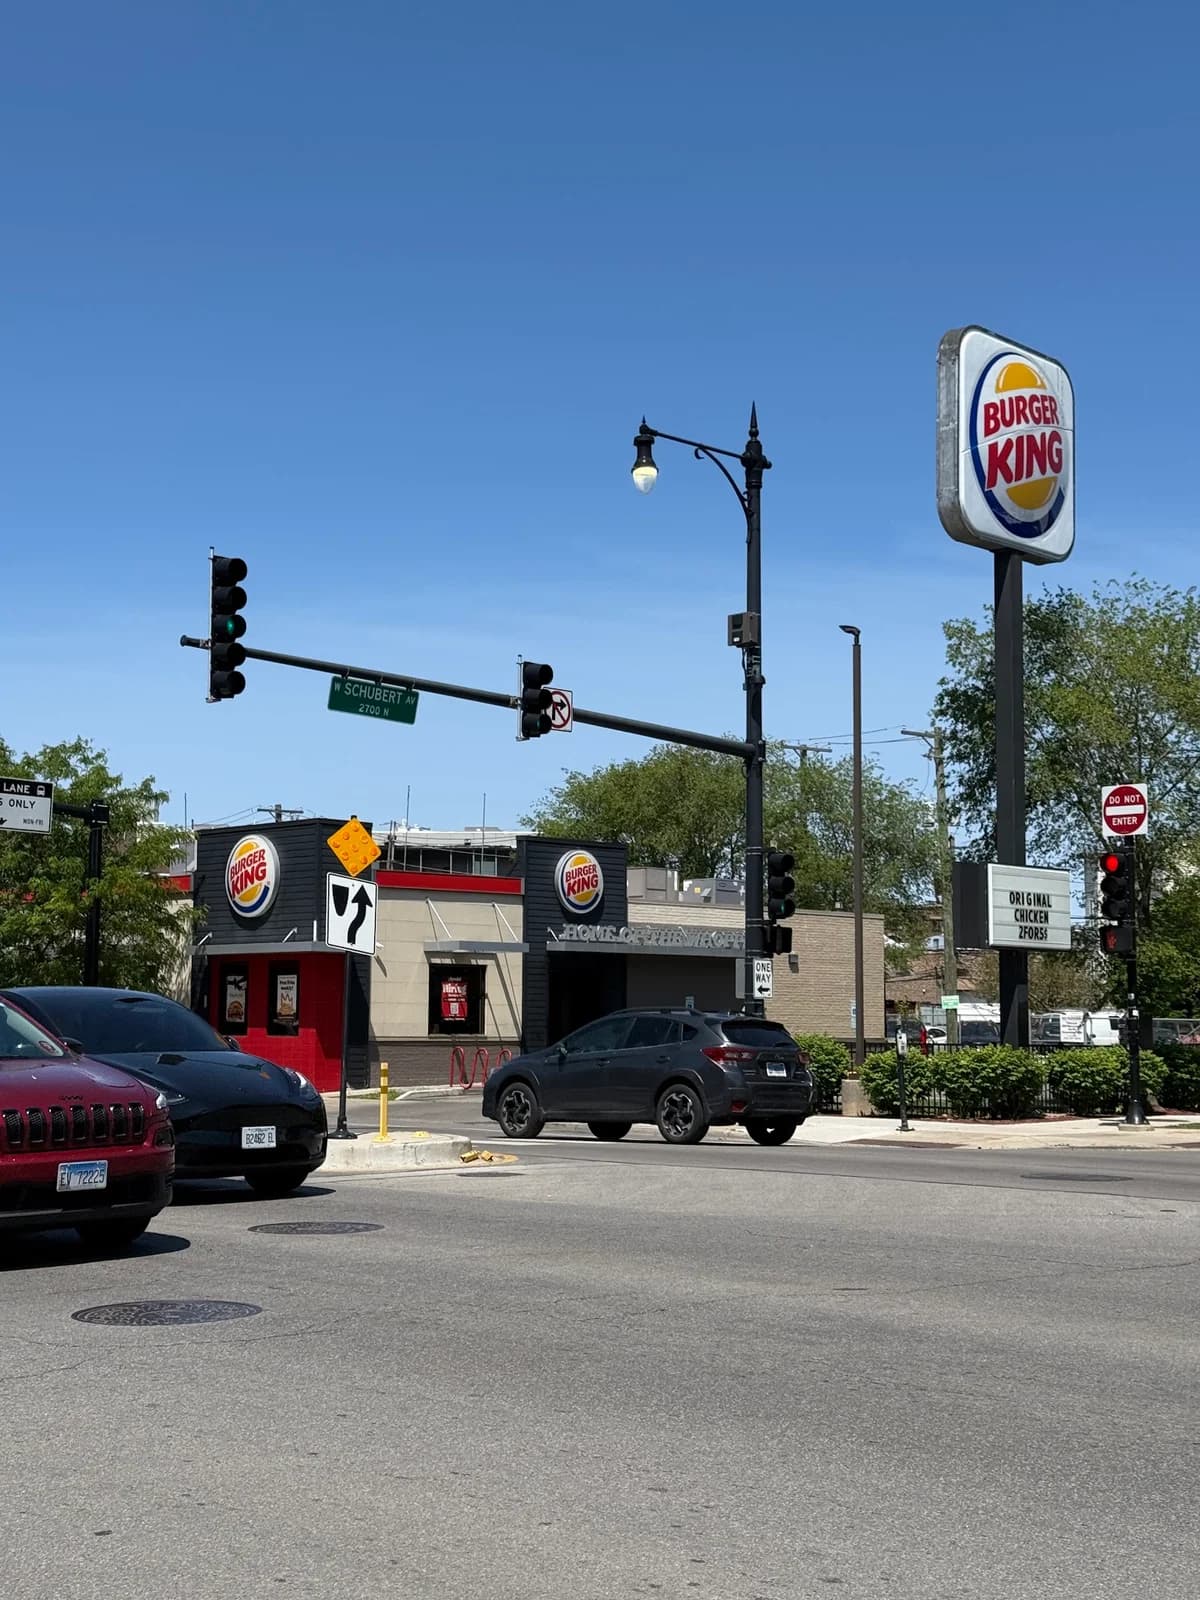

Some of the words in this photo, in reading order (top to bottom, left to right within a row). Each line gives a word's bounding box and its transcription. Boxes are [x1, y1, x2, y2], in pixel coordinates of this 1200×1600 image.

[984, 394, 1060, 437] BURGER
[986, 430, 1063, 489] KING
[334, 682, 342, 692] W
[344, 682, 403, 705] SCHUBERT
[405, 696, 416, 705] AV
[359, 703, 381, 716] 2700
[383, 707, 390, 717] N
[3, 782, 31, 794] LANE
[8, 798, 36, 809] ONLY
[1109, 796, 1120, 805] DO
[1124, 794, 1140, 803] NOT
[1112, 816, 1138, 826] ENTER
[230, 849, 266, 880] BURGER
[231, 862, 267, 899] KING
[566, 864, 597, 882] BURGER
[567, 874, 599, 897] KING
[1009, 891, 1052, 908] ORIGINAL
[1014, 909, 1049, 924] CHICKEN
[563, 923, 617, 942] HOME
[619, 926, 645, 945] OF
[685, 930, 746, 950] WHOPP
[756, 962, 771, 972] ONE
[756, 973, 771, 983] WAY
[78, 1169, 106, 1184] 72225
